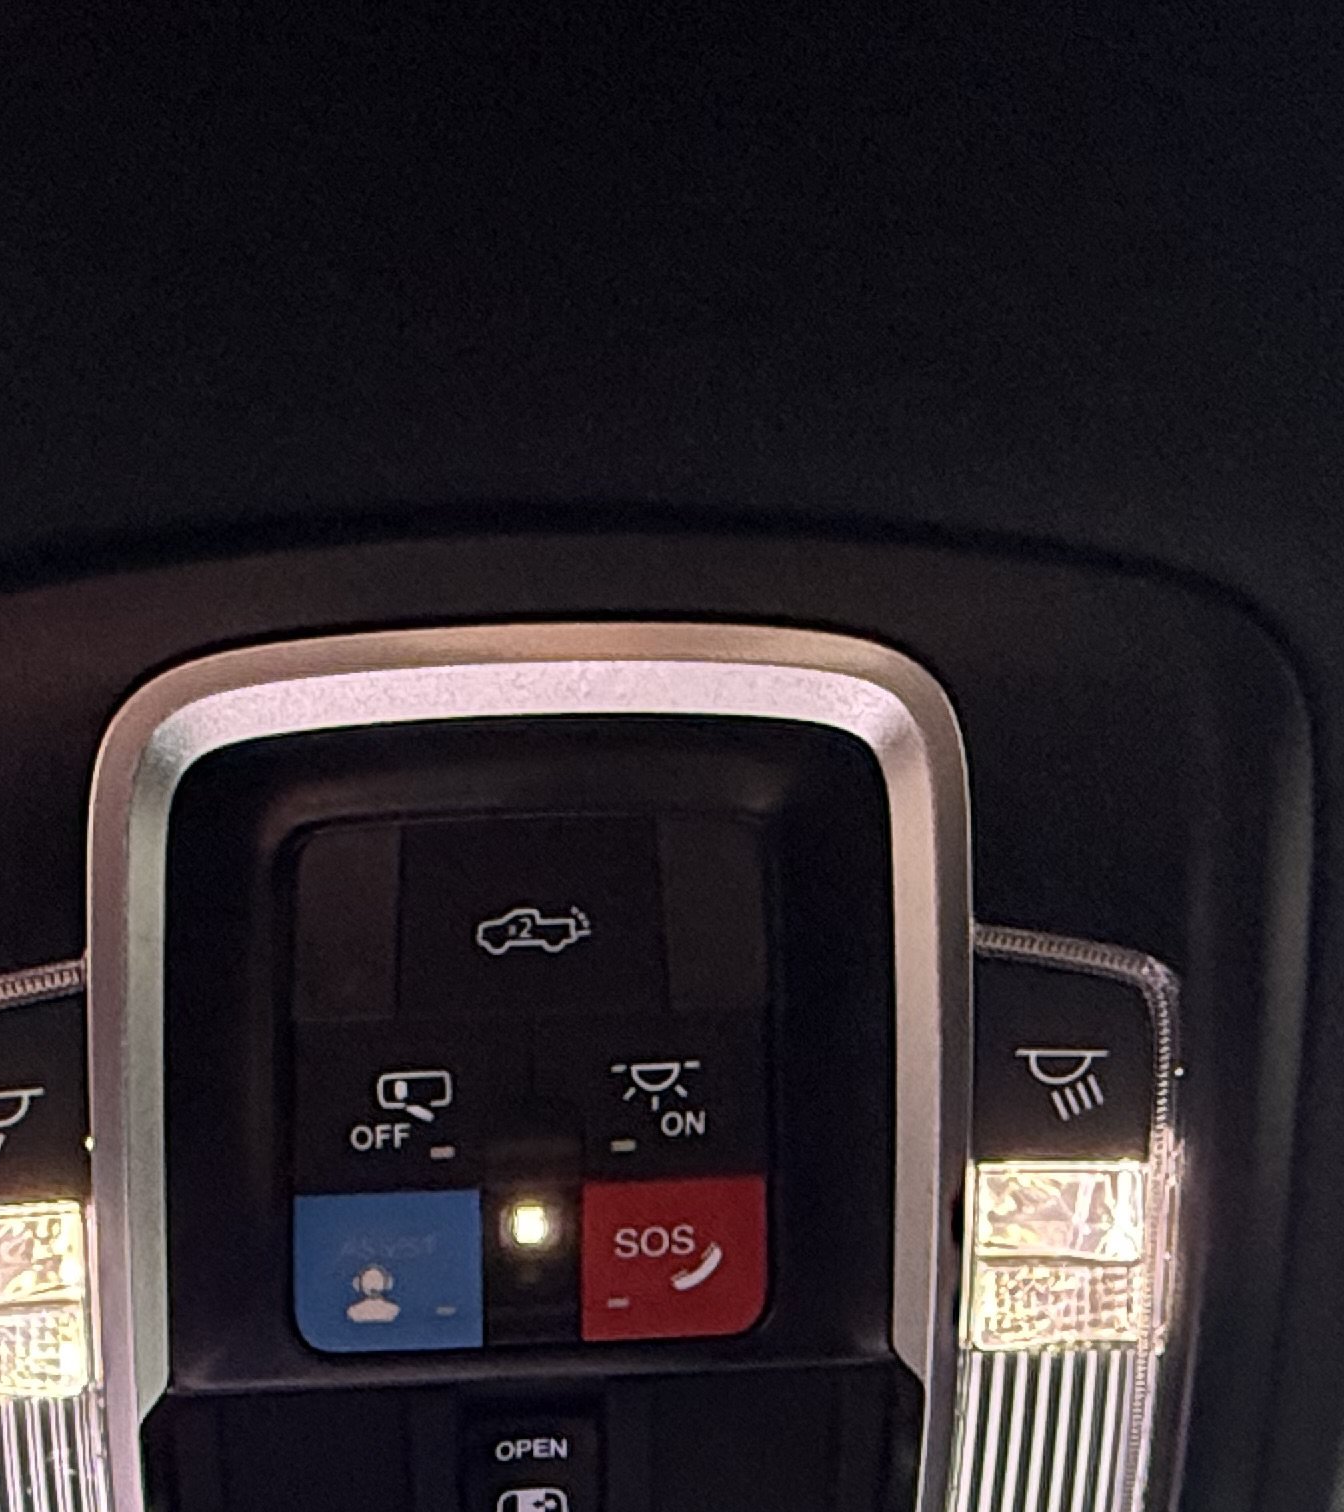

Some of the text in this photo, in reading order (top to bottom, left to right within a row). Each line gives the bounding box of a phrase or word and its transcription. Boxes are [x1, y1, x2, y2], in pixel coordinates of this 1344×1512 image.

[661, 1110, 706, 1136] ON
[350, 1123, 411, 1151] OFF
[614, 1225, 695, 1258] SOS
[495, 1438, 568, 1461] OPEN
